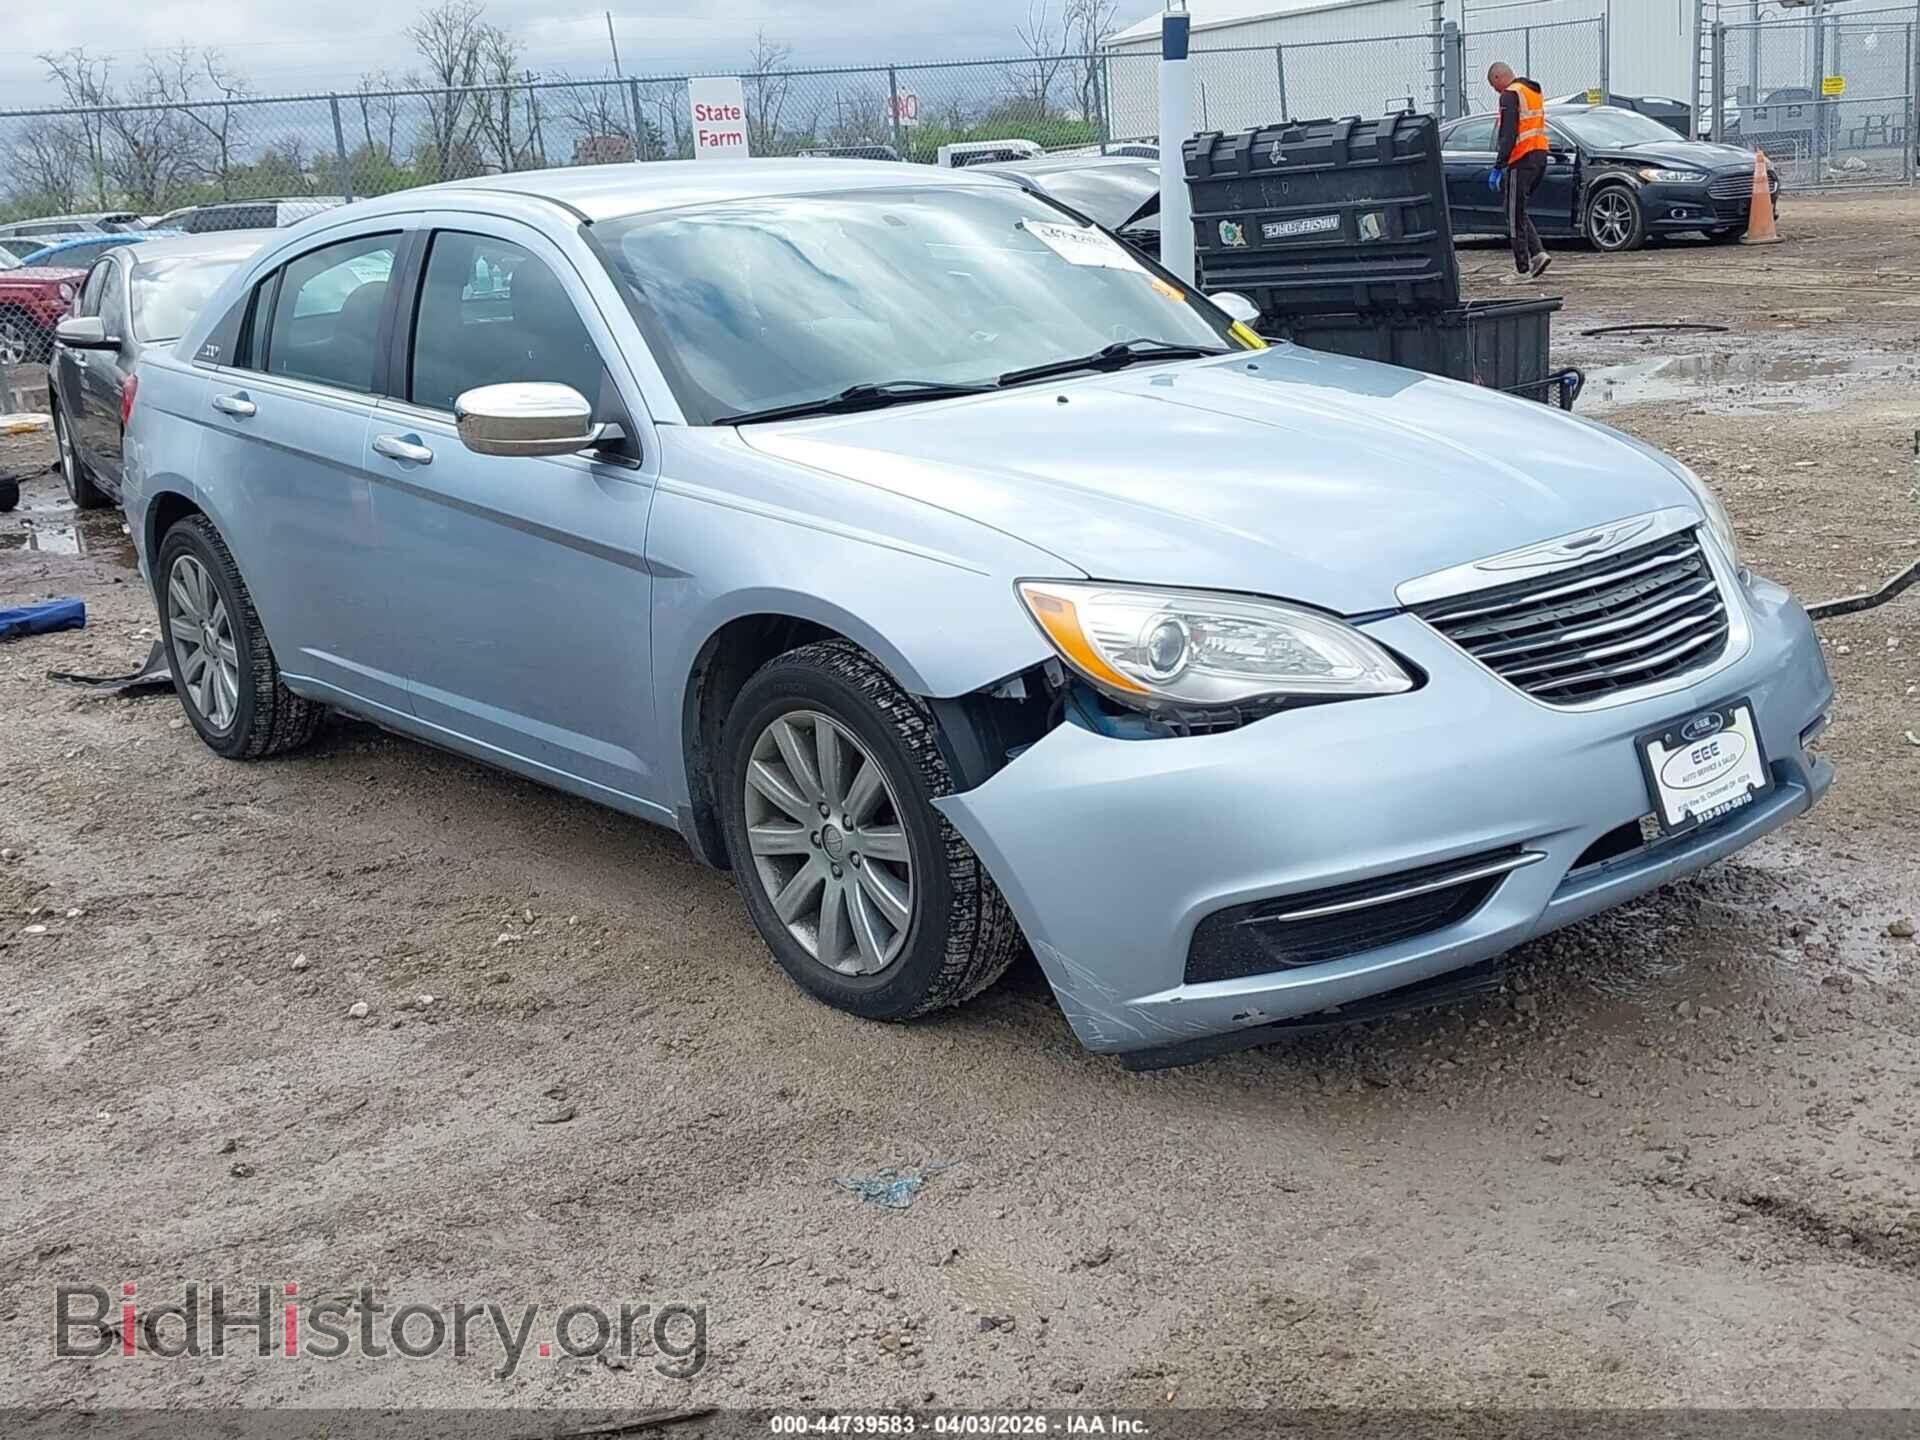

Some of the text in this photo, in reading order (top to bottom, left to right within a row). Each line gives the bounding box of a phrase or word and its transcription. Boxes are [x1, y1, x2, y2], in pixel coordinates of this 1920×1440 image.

[695, 104, 741, 121] State
[699, 129, 743, 147] Farm
[1691, 741, 1721, 765] EEE
